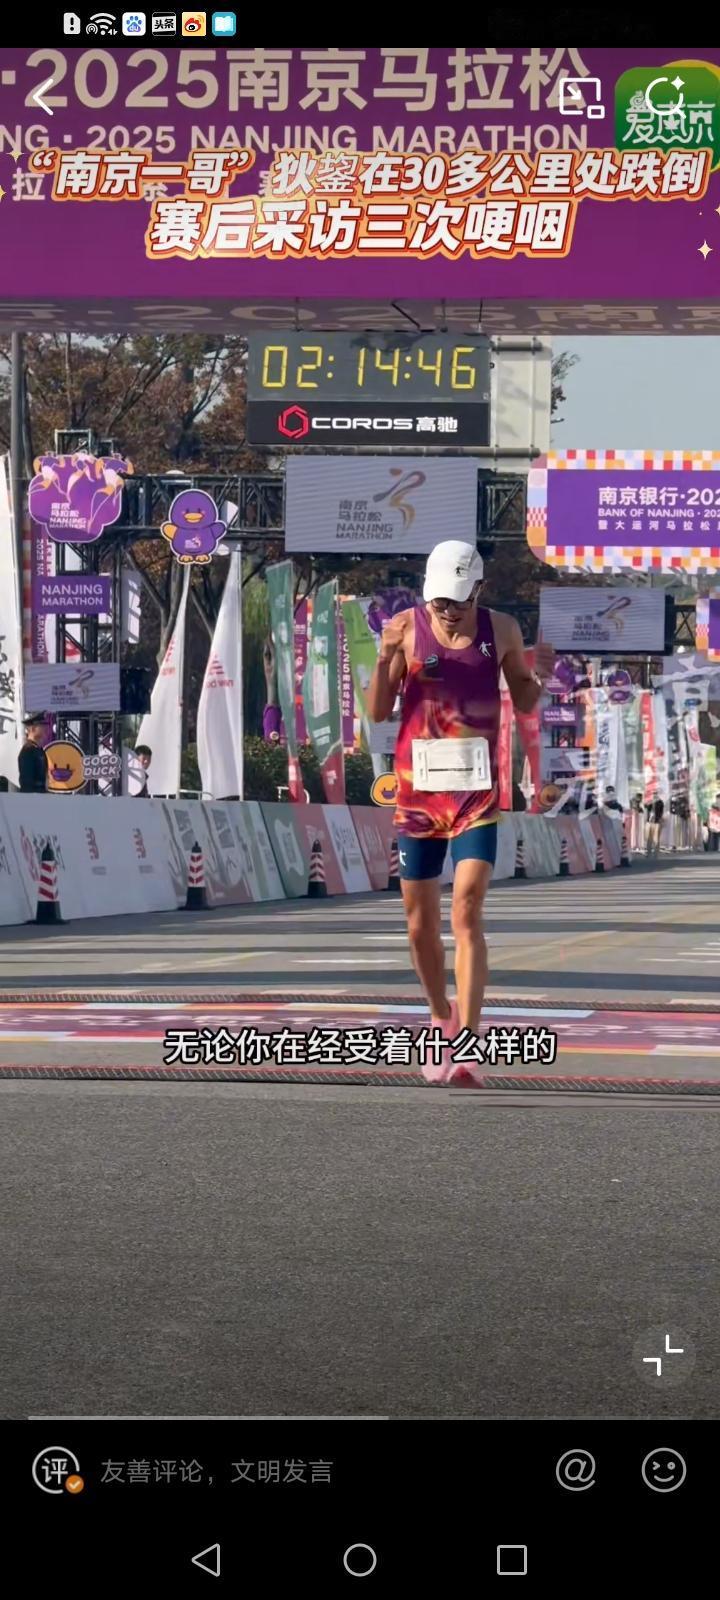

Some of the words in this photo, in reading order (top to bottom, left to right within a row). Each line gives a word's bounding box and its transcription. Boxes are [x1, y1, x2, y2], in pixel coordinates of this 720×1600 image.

[86, 125, 176, 152] 2025
[191, 125, 358, 155] NANJING
[372, 124, 588, 153] MARATHON
[262, 345, 476, 389] 02:14:46
[311, 417, 413, 430] COROS
[416, 416, 458, 433] 高驰
[598, 508, 627, 517] BANK
[630, 508, 644, 517] OF
[647, 508, 695, 518] NANJING
[336, 523, 393, 533] NANJING
[41, 583, 104, 596] NANJING
[41, 597, 104, 607] MARATHON
[83, 755, 118, 766] GOGO
[84, 766, 117, 776] DUCK
